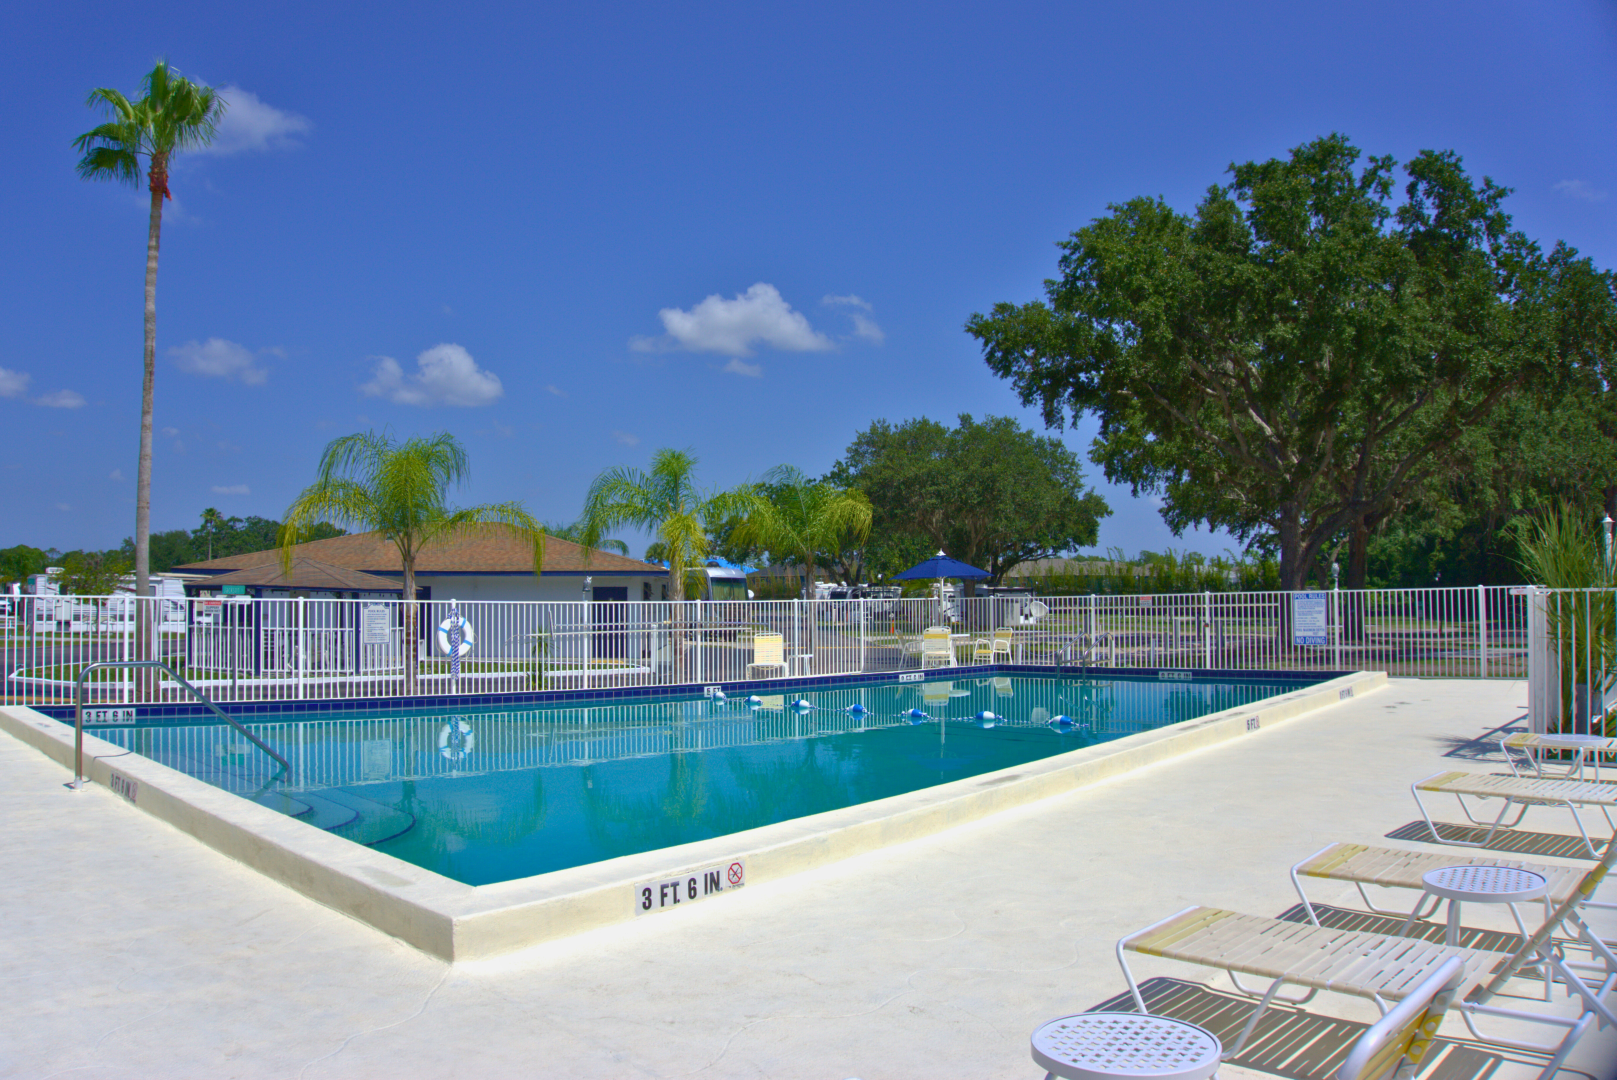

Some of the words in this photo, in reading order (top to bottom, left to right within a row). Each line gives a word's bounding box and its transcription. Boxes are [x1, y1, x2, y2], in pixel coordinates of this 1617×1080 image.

[122, 710, 134, 722] IN
[642, 887, 652, 910] 3
[660, 880, 681, 907] FT.
[687, 877, 697, 900] 6
